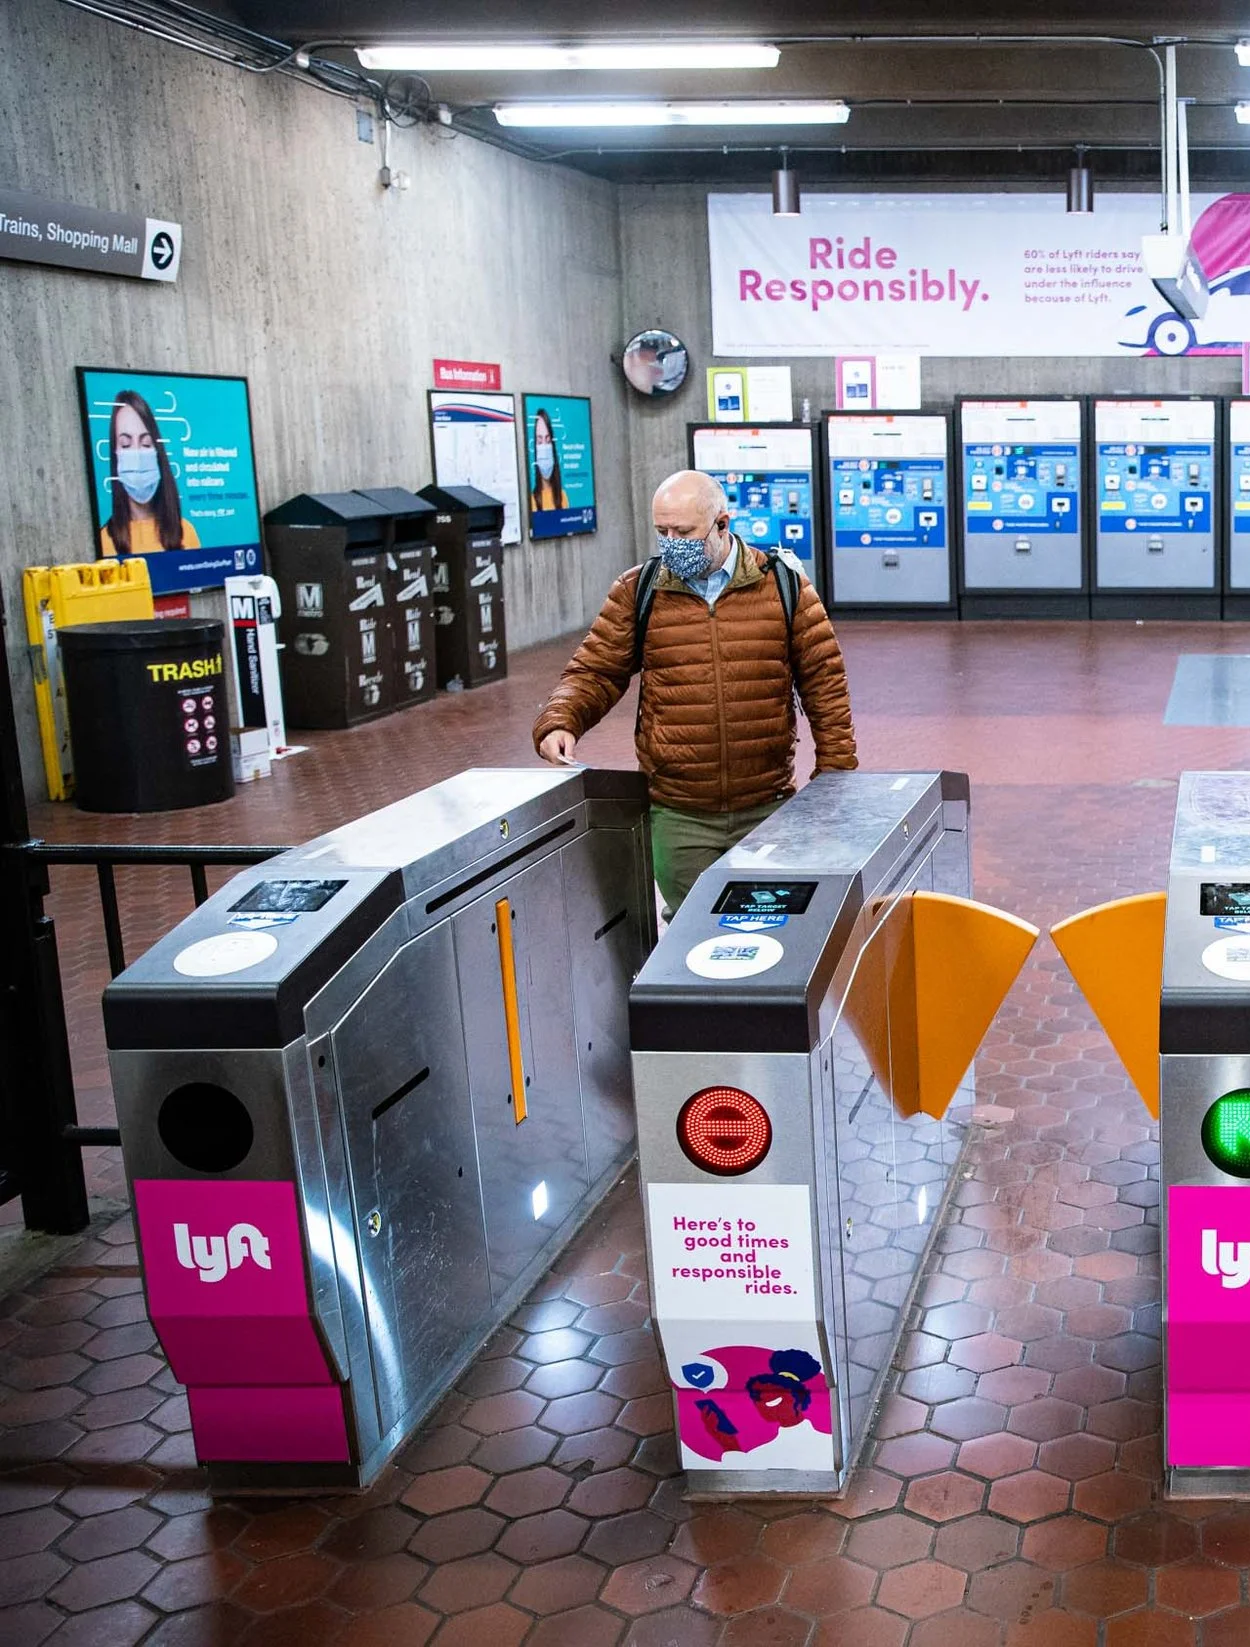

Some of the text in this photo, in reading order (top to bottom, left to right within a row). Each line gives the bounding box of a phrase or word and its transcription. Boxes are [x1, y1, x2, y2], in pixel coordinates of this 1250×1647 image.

[0, 213, 138, 255] Trains, Shopping Mall
[809, 236, 898, 270] Ride
[1048, 249, 1060, 260] of
[1063, 249, 1083, 261] Lyft
[1085, 249, 1118, 260] riders
[1121, 251, 1141, 262] say
[1024, 264, 1144, 276] are less likely to drive
[739, 269, 990, 312] Responsibly.
[1024, 278, 1132, 288] under the influence
[1024, 293, 1111, 304] because of Lyft.
[296, 583, 323, 609] M
[232, 597, 254, 619] M
[245, 628, 258, 654] Hand
[248, 654, 261, 696] Sanitizer
[673, 1216, 756, 1232] Here's to
[684, 1234, 789, 1251] good times
[173, 1222, 272, 1283] lyft
[720, 1249, 756, 1263] and
[672, 1265, 782, 1282] responsible
[745, 1281, 798, 1295] rides.
